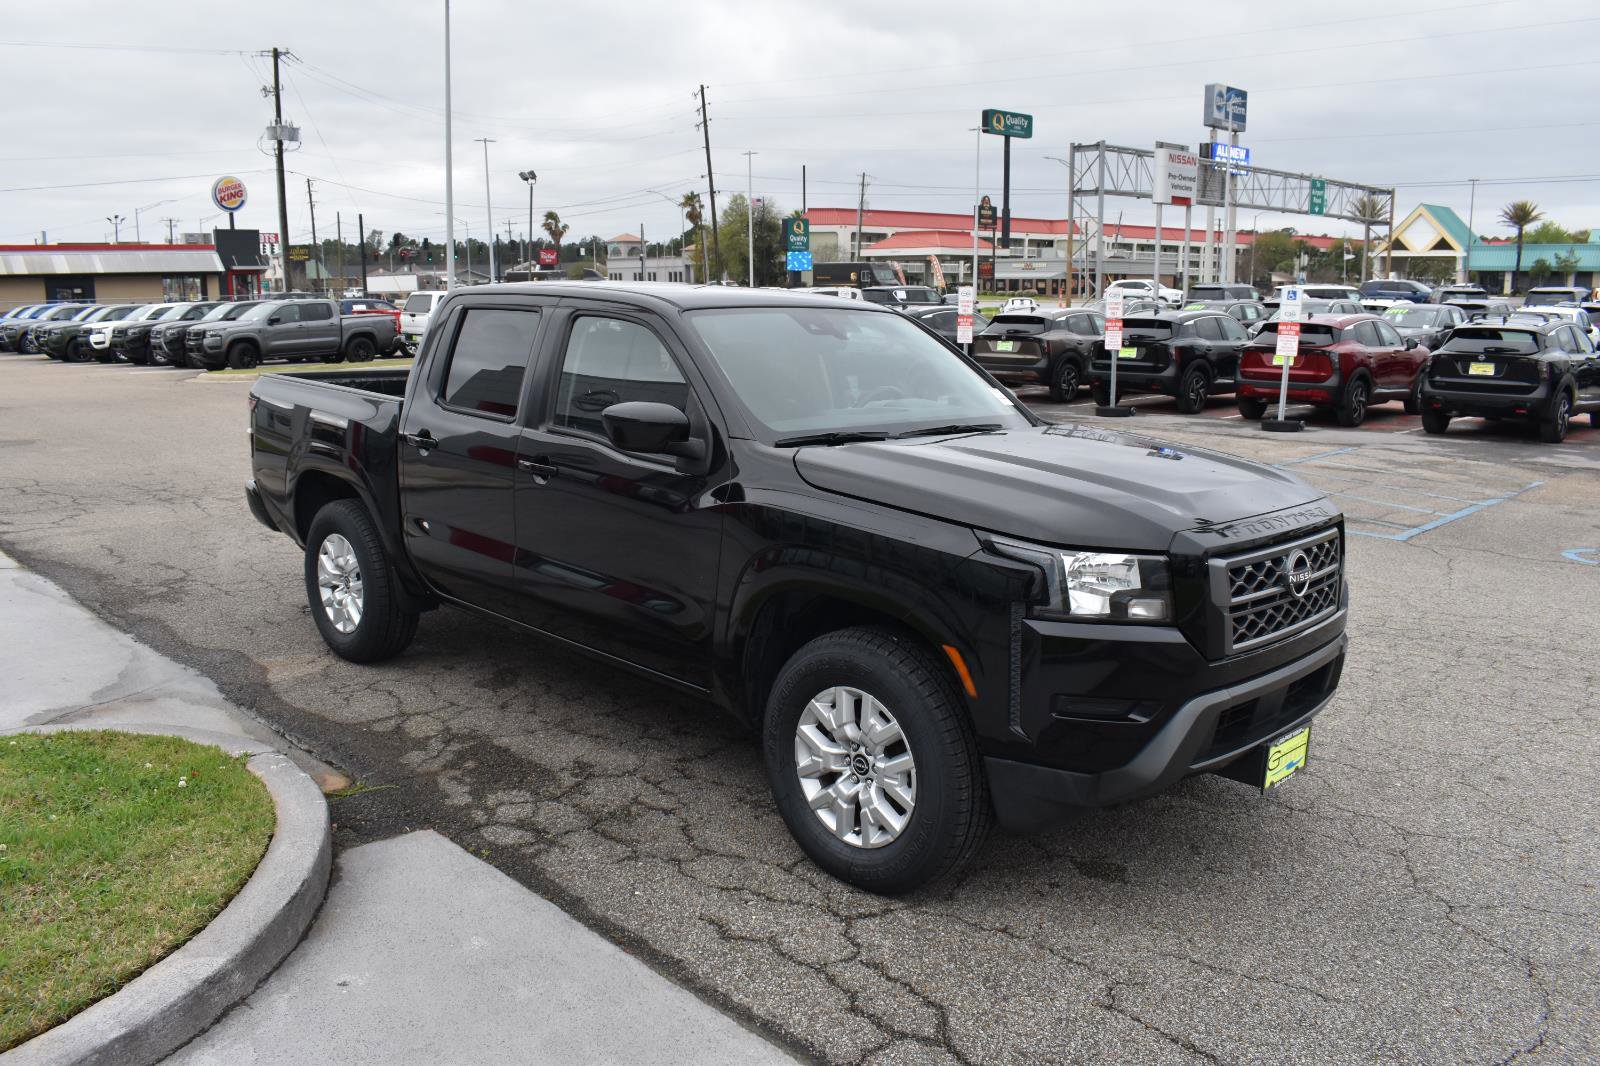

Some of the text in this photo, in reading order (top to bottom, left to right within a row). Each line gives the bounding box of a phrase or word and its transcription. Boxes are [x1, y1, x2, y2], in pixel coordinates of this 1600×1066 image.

[1005, 114, 1029, 128] Quality
[1169, 153, 1197, 167] NISSAN
[1168, 172, 1197, 183] Pre-Owned
[217, 182, 242, 195] BURGER
[220, 189, 244, 203] KING
